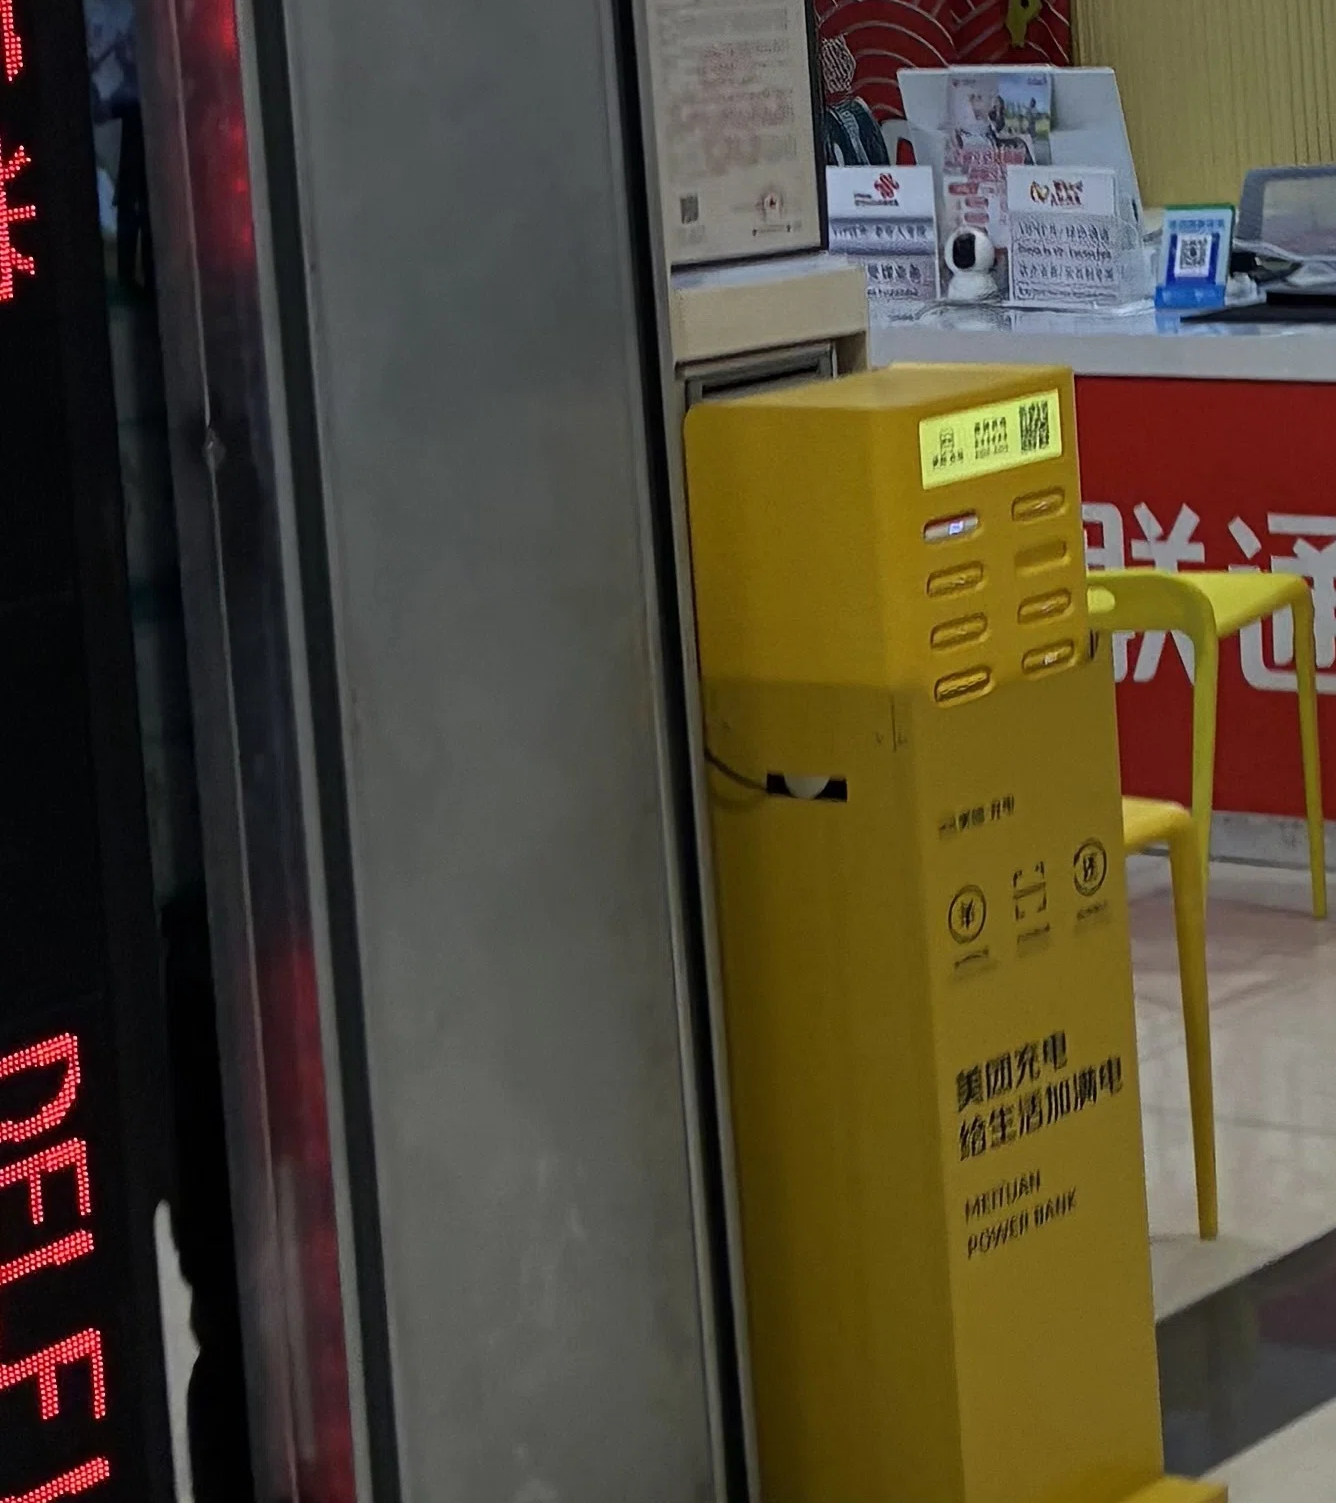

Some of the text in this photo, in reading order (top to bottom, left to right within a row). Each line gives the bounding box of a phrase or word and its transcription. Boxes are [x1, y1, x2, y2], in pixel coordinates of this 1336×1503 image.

[956, 1029, 1068, 1112] 美团充电
[959, 1055, 1123, 1162] 给生活加满电
[964, 1168, 1041, 1225] MEITUAN
[967, 1184, 1077, 1260] POWER BANK
